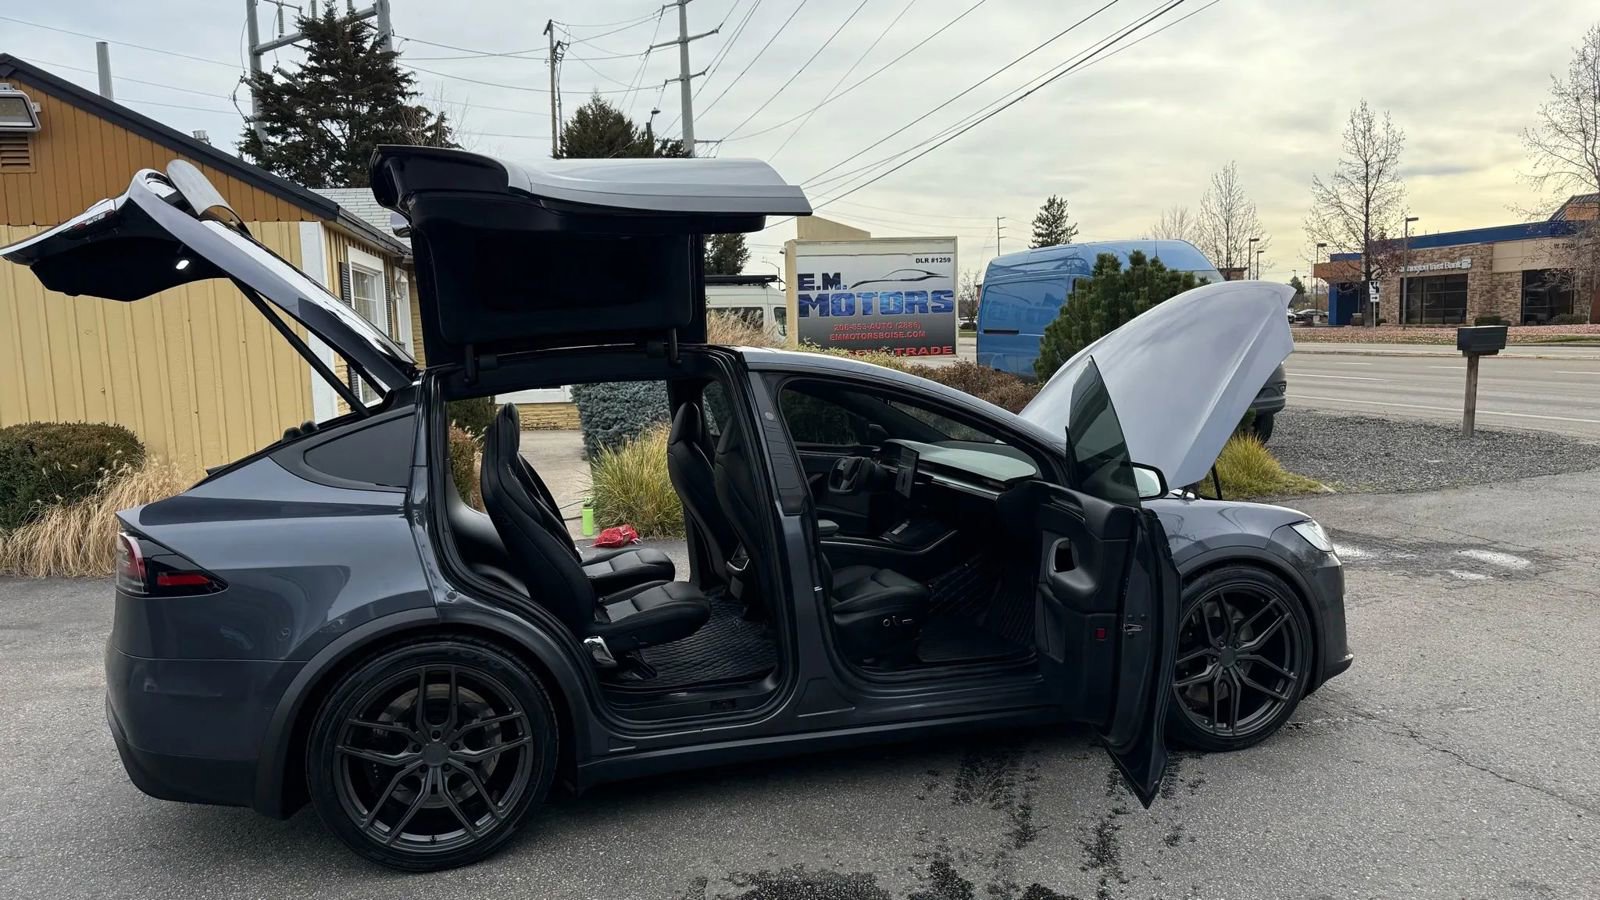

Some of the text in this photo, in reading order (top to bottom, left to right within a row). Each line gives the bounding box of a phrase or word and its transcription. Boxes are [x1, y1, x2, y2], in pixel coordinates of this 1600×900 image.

[797, 272, 848, 291] E.M.
[798, 290, 954, 317] MOTORS
[829, 331, 926, 341] EMMOTORSBOISE.COM
[894, 346, 953, 356] TRADE
